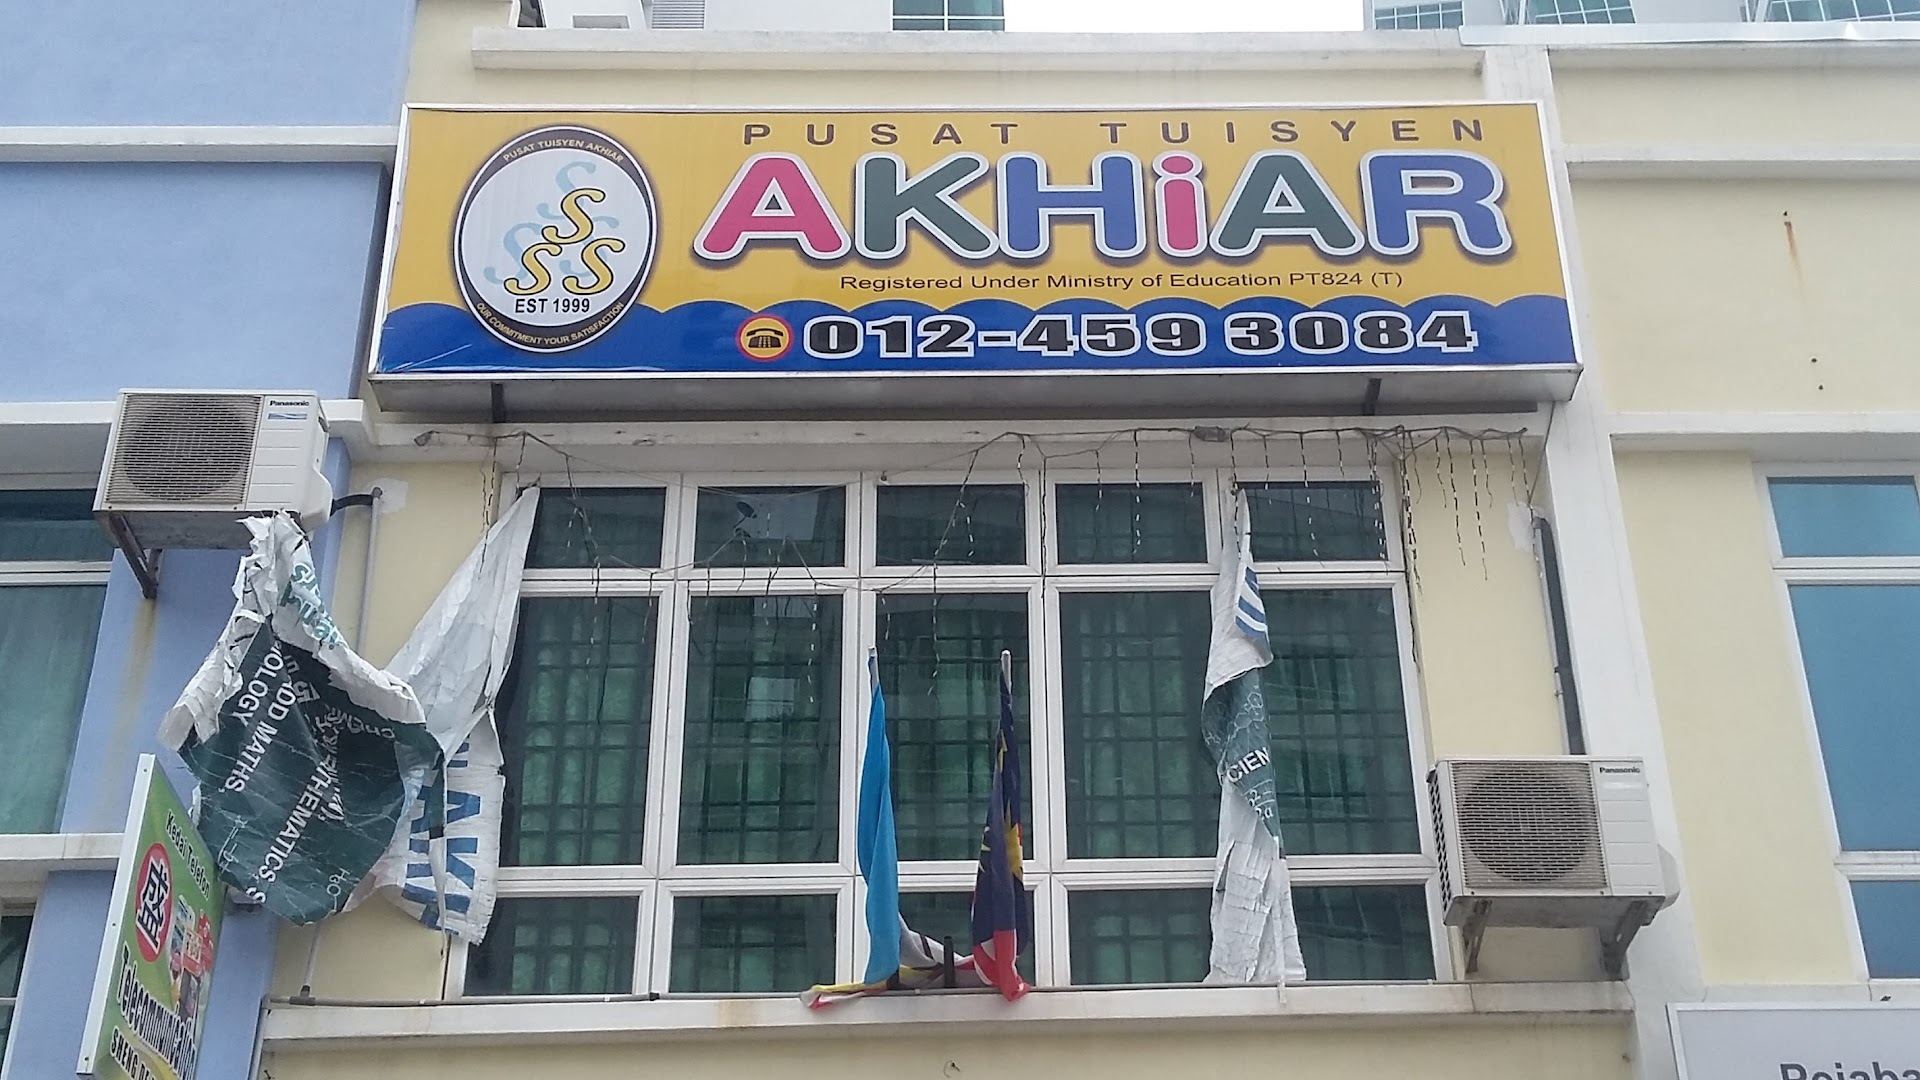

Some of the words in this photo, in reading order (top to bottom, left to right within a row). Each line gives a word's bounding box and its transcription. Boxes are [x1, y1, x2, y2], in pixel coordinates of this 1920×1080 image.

[743, 122, 1018, 145] PUSAT
[1100, 119, 1484, 143] TUISYEN
[503, 143, 535, 161] PUSAT
[538, 139, 584, 148] TUISYEN
[586, 142, 624, 162] AKHIAR
[840, 276, 962, 291] Registered
[971, 275, 1040, 289] Under
[1047, 274, 1134, 291] Ministry
[1141, 274, 1163, 287] of
[1170, 273, 1281, 287] Education
[1289, 272, 1363, 286] PT824
[1371, 271, 1403, 287] (T)
[515, 298, 548, 313] EST
[552, 298, 590, 313] 1999
[476, 302, 491, 319] OUR
[489, 315, 543, 345] COMMITMENT
[543, 335, 570, 345] YOUR
[571, 302, 624, 341] SATISFACTION
[803, 312, 1207, 361] 012-459
[1222, 309, 1479, 357] 3084
[218, 720, 278, 793] MATHS,
[1599, 766, 1641, 774] Panasonic
[165, 809, 188, 860] Kedai
[186, 844, 210, 901] Telefon
[110, 1026, 139, 1080] SHENG
